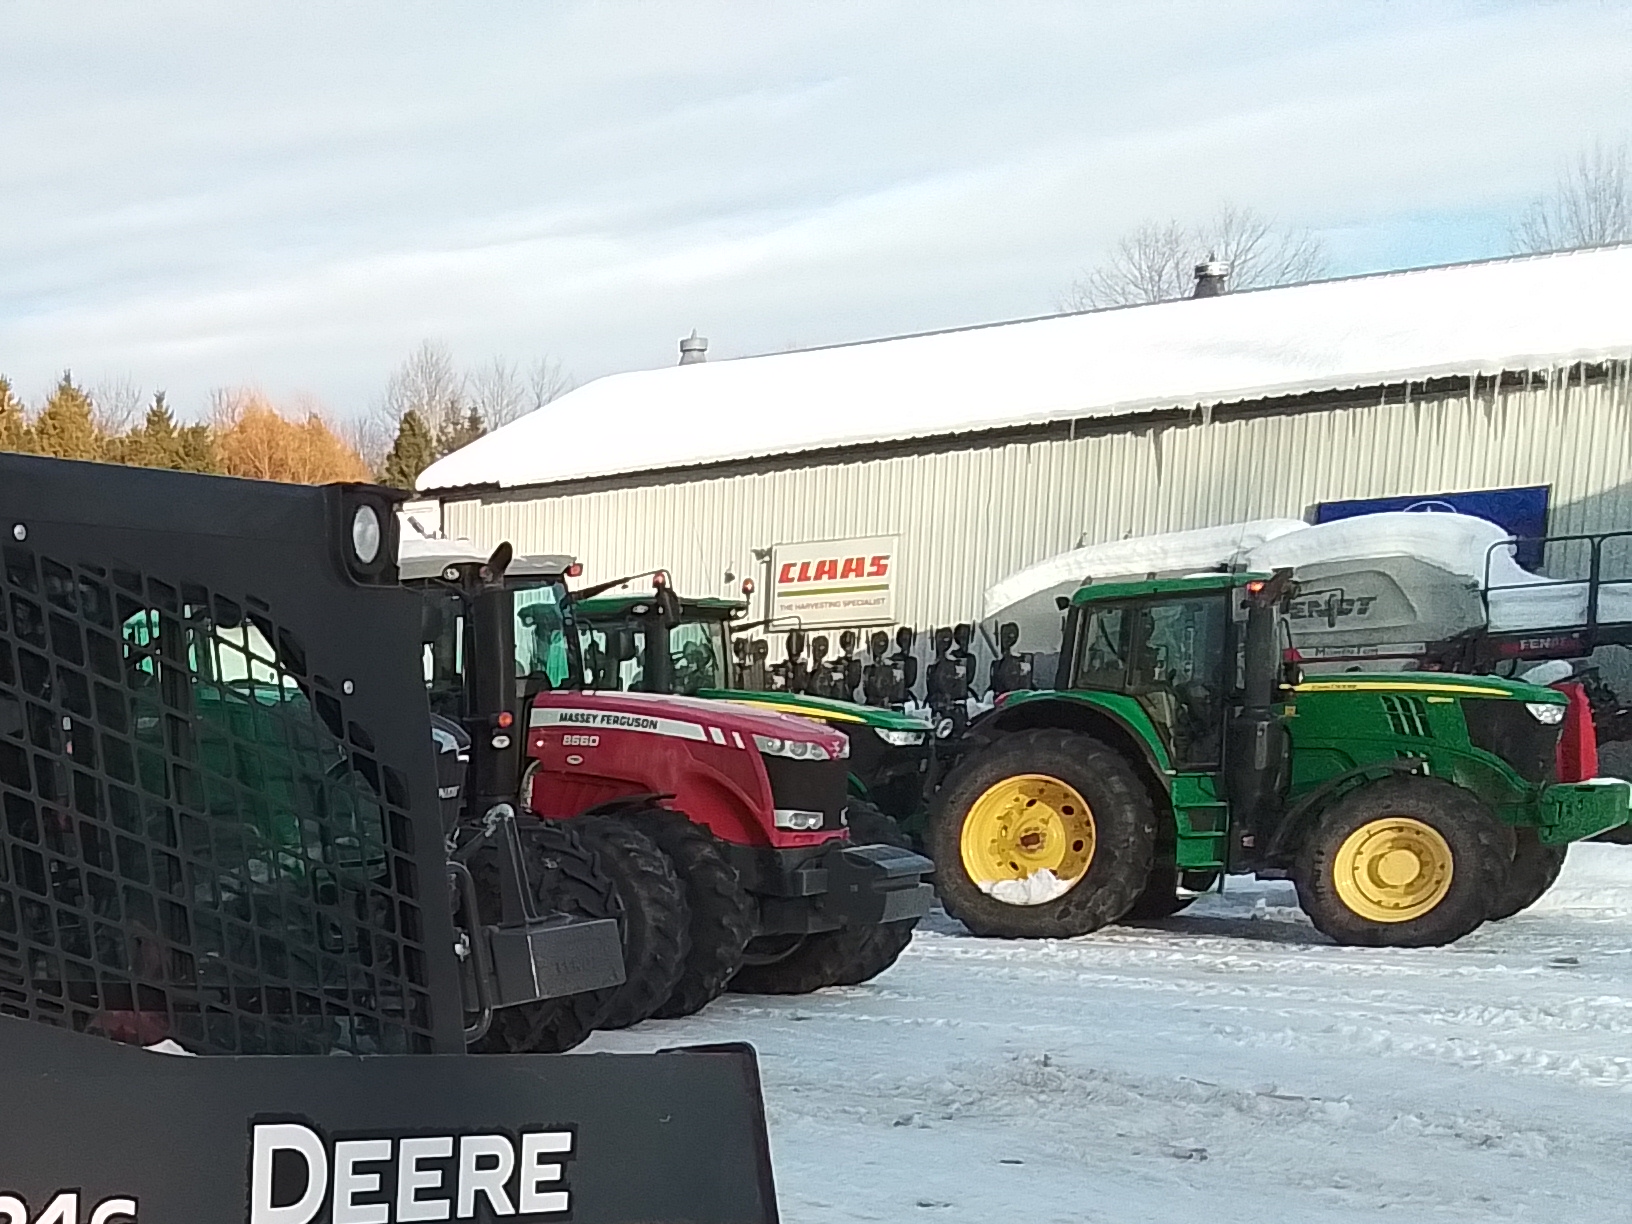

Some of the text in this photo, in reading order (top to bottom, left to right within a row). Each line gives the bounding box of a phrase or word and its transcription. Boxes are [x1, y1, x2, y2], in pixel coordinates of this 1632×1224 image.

[778, 554, 891, 584] CLAAS
[795, 600, 841, 611] HARVESTING
[842, 597, 886, 608] SPECIALIST
[558, 712, 659, 730] MASSEY FERGUSON
